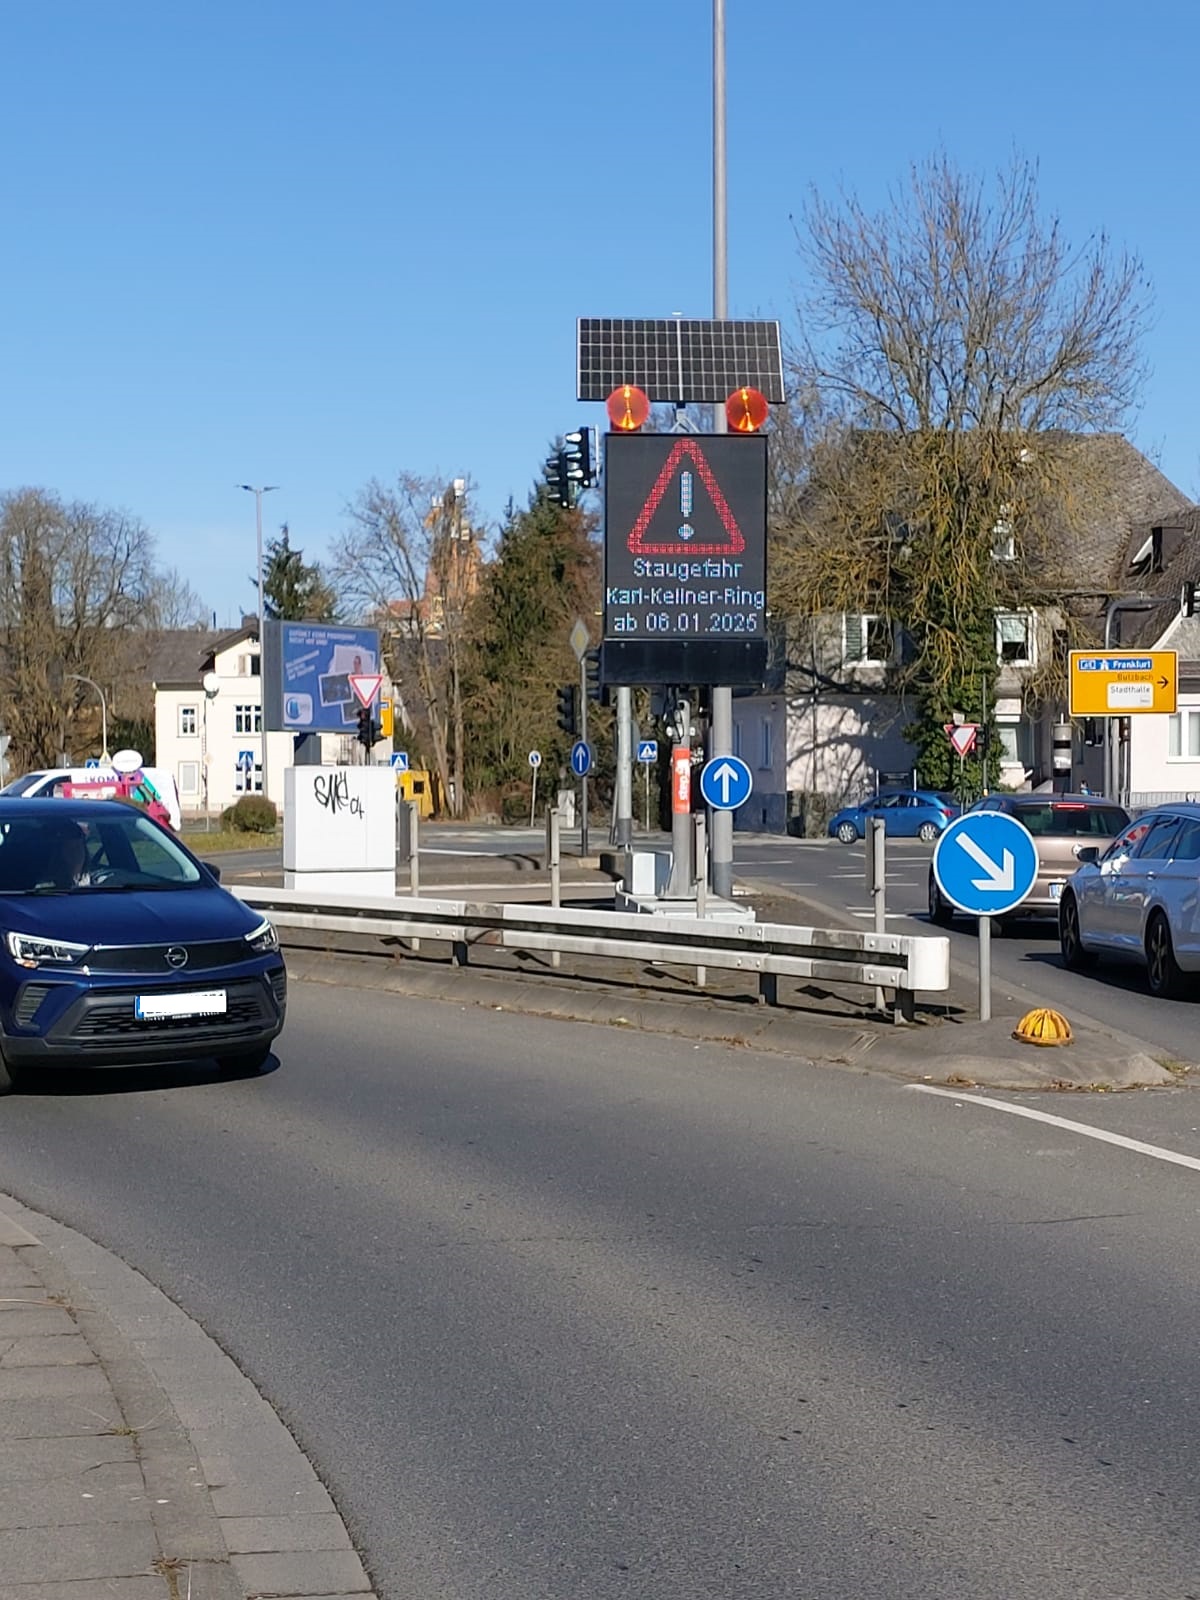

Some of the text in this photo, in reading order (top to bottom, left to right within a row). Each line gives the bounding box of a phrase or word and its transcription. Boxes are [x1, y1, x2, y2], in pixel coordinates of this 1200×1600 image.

[633, 557, 743, 582] Staugefahr
[606, 585, 765, 609] Karl-Kellner-Ring
[613, 612, 638, 632] ab
[1112, 660, 1151, 669] Frankfurt
[1110, 685, 1150, 694] Stadthalle
